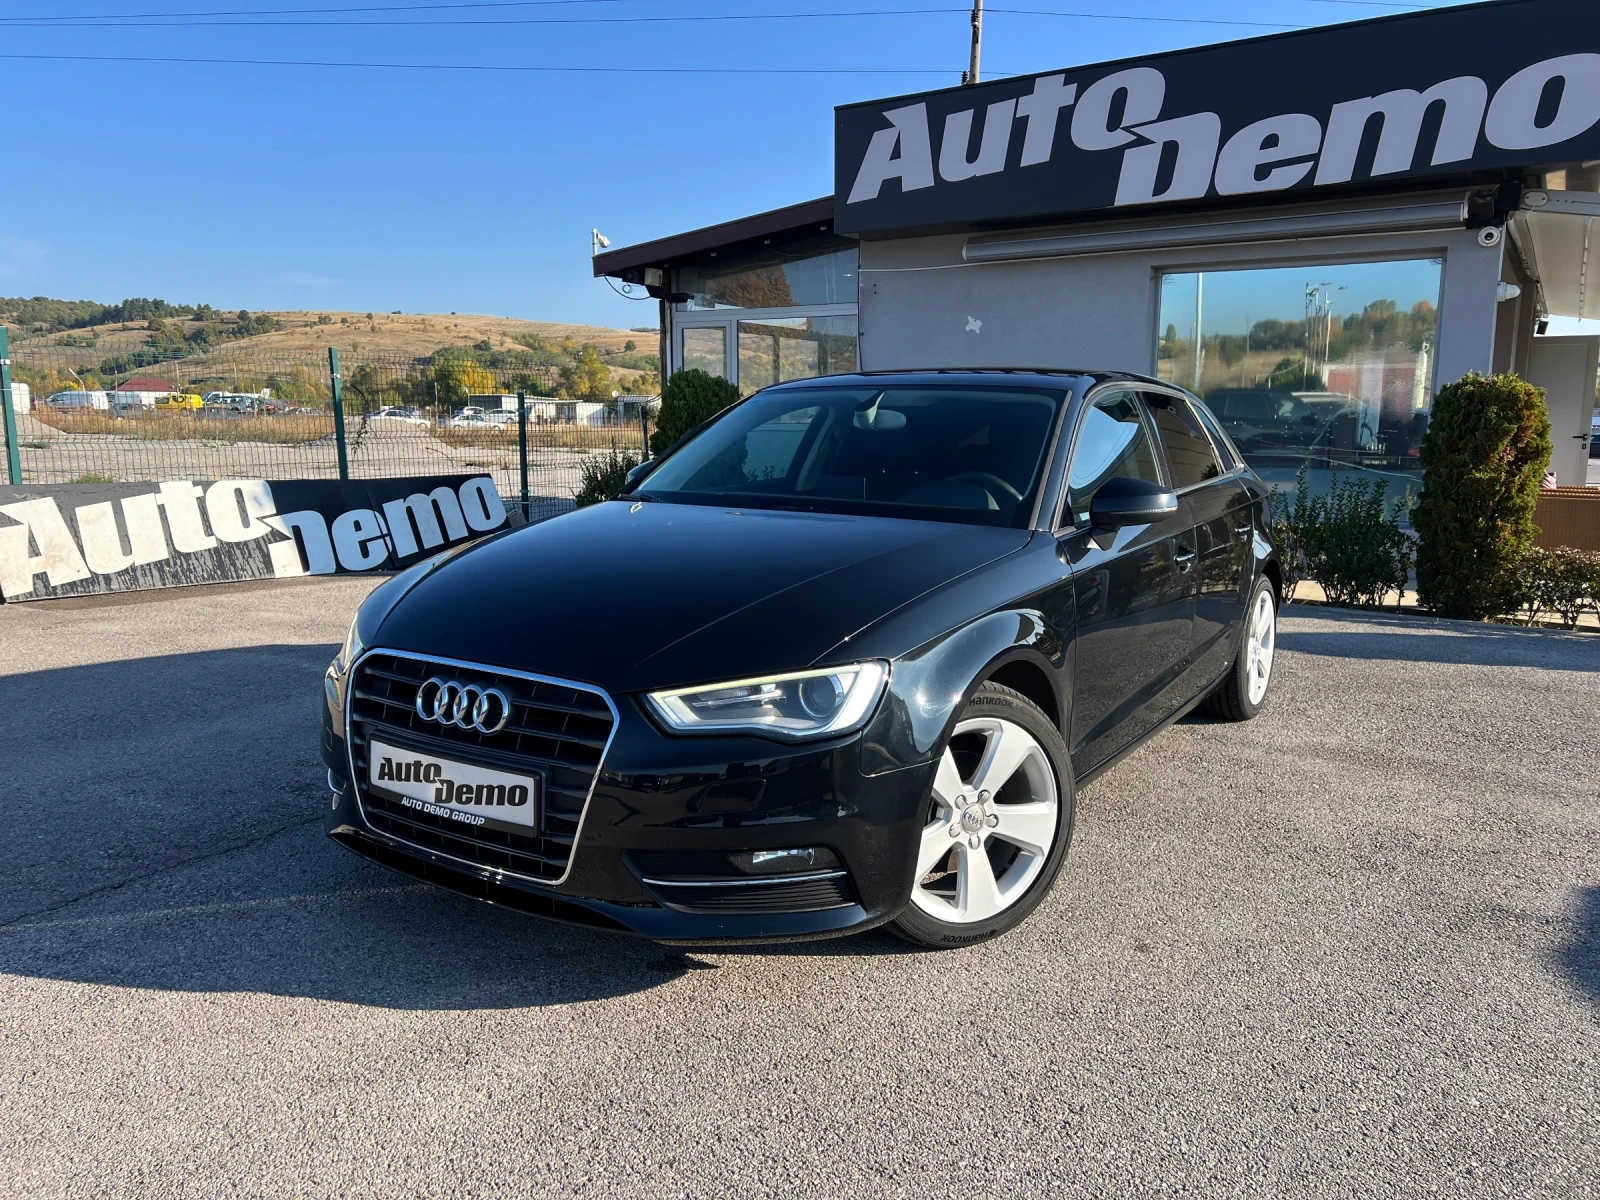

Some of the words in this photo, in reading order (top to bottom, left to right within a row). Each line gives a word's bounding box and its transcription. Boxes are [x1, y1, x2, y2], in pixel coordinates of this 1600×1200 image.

[847, 66, 1166, 204] Auto
[1114, 52, 1600, 206] Demo
[0, 480, 275, 597] Auto
[268, 476, 507, 578] Demo
[379, 758, 442, 783] Auto
[435, 779, 529, 807] Demo
[402, 797, 423, 810] AUTO
[424, 805, 450, 818] DEMO
[452, 811, 485, 826] GROUP
